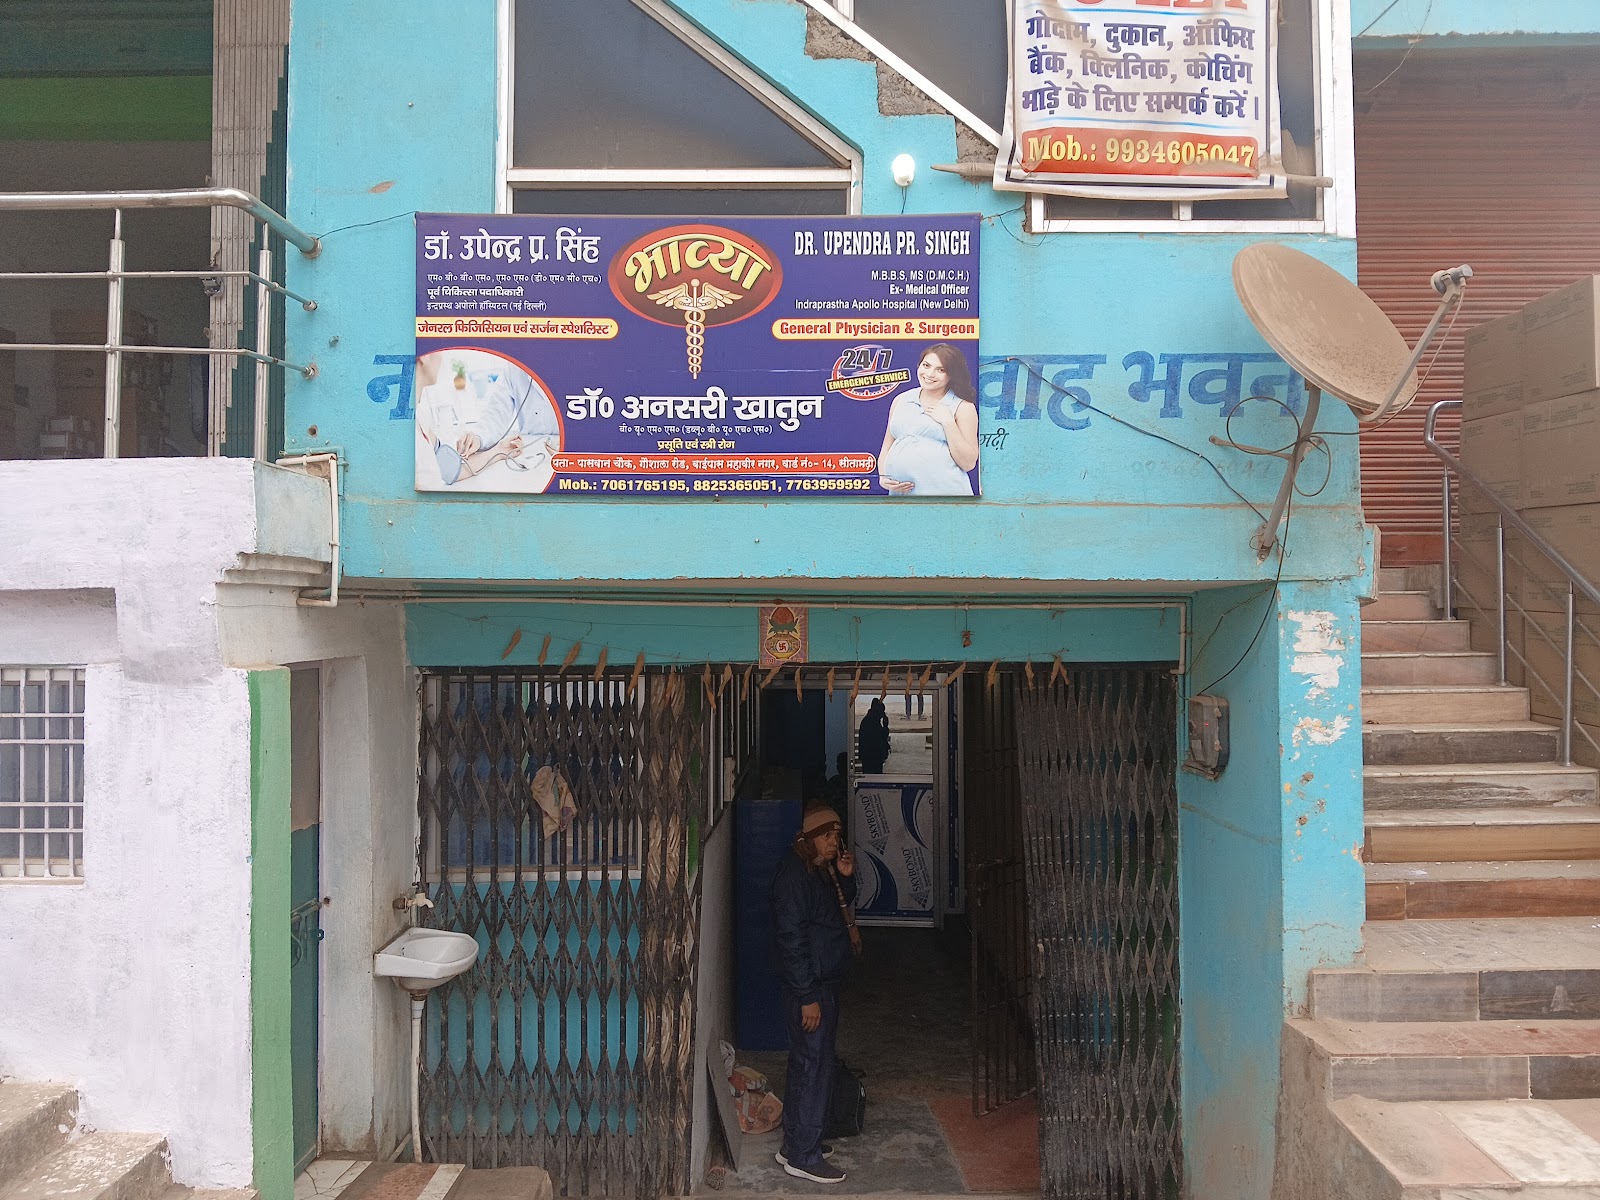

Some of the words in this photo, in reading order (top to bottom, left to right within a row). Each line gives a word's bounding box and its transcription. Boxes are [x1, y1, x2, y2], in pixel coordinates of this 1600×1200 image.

[1026, 10, 1096, 49] गोदाम,
[1104, 22, 1173, 53] दुकान,
[1183, 18, 1256, 50] ऑफिस
[1027, 45, 1073, 80] बैंक,
[1184, 52, 1253, 84] कोचिंग
[1022, 81, 1061, 114] भाड़े
[1065, 82, 1089, 109] के
[1093, 84, 1140, 112] लिए
[1143, 87, 1209, 114] सम्पर्क
[1028, 134, 1096, 161] Mob.:
[1106, 138, 1254, 168] 9934605047
[424, 230, 454, 260] डॉ.
[460, 228, 523, 263] उपेन्द्र
[528, 235, 549, 264] प्र.
[556, 226, 601, 264] सिंह
[794, 231, 818, 255] DR.
[824, 231, 891, 255] UPENDRA
[896, 231, 920, 255] PR.
[925, 230, 970, 255] SINGH
[625, 233, 772, 293] भाव्या
[910, 270, 923, 280] MS
[926, 270, 970, 282] (D.M.C.H.)
[427, 286, 440, 300] पूर्व
[442, 286, 478, 296] चिकित्सा
[480, 286, 524, 296] पदाधिकारी
[890, 284, 903, 294] Ex-
[906, 284, 938, 294] Medical
[941, 284, 970, 294] Officer
[455, 300, 477, 310] अपोलो
[480, 300, 508, 310] हॉस्पिटल
[795, 299, 849, 311] Indraprastha
[852, 299, 880, 311] Apollo
[882, 299, 917, 311] Hospital
[920, 299, 941, 311] (New
[944, 299, 970, 311] Delhi)
[418, 320, 453, 333] जेनरल
[455, 320, 511, 334] फिजिसियन
[514, 320, 528, 333] एवं
[530, 321, 559, 334] सर्जन
[561, 321, 610, 335] स्पेशलिस्ट
[780, 322, 831, 334] General
[836, 322, 900, 336] Physician
[904, 322, 915, 334] &
[919, 322, 974, 336] Surgeon
[828, 376, 874, 390] EMERGENCY
[875, 371, 908, 384] SERVICE
[1122, 351, 1303, 418] भवन
[566, 388, 615, 420] डॉ०
[621, 386, 728, 419] अनसरी
[732, 395, 824, 431] खातुन
[657, 438, 683, 452] प्रसूति
[685, 438, 698, 449] एवं
[700, 438, 716, 449] स्त्री
[718, 438, 735, 450] रोग
[822, 459, 836, 469] 14,
[560, 479, 597, 490] Mob.:
[601, 480, 690, 492] 7061765195,
[694, 480, 782, 492] 8825365051,
[786, 480, 870, 490] 7763959592
[862, 796, 879, 838] SKYBOND
[902, 849, 920, 892] SKYBOND
